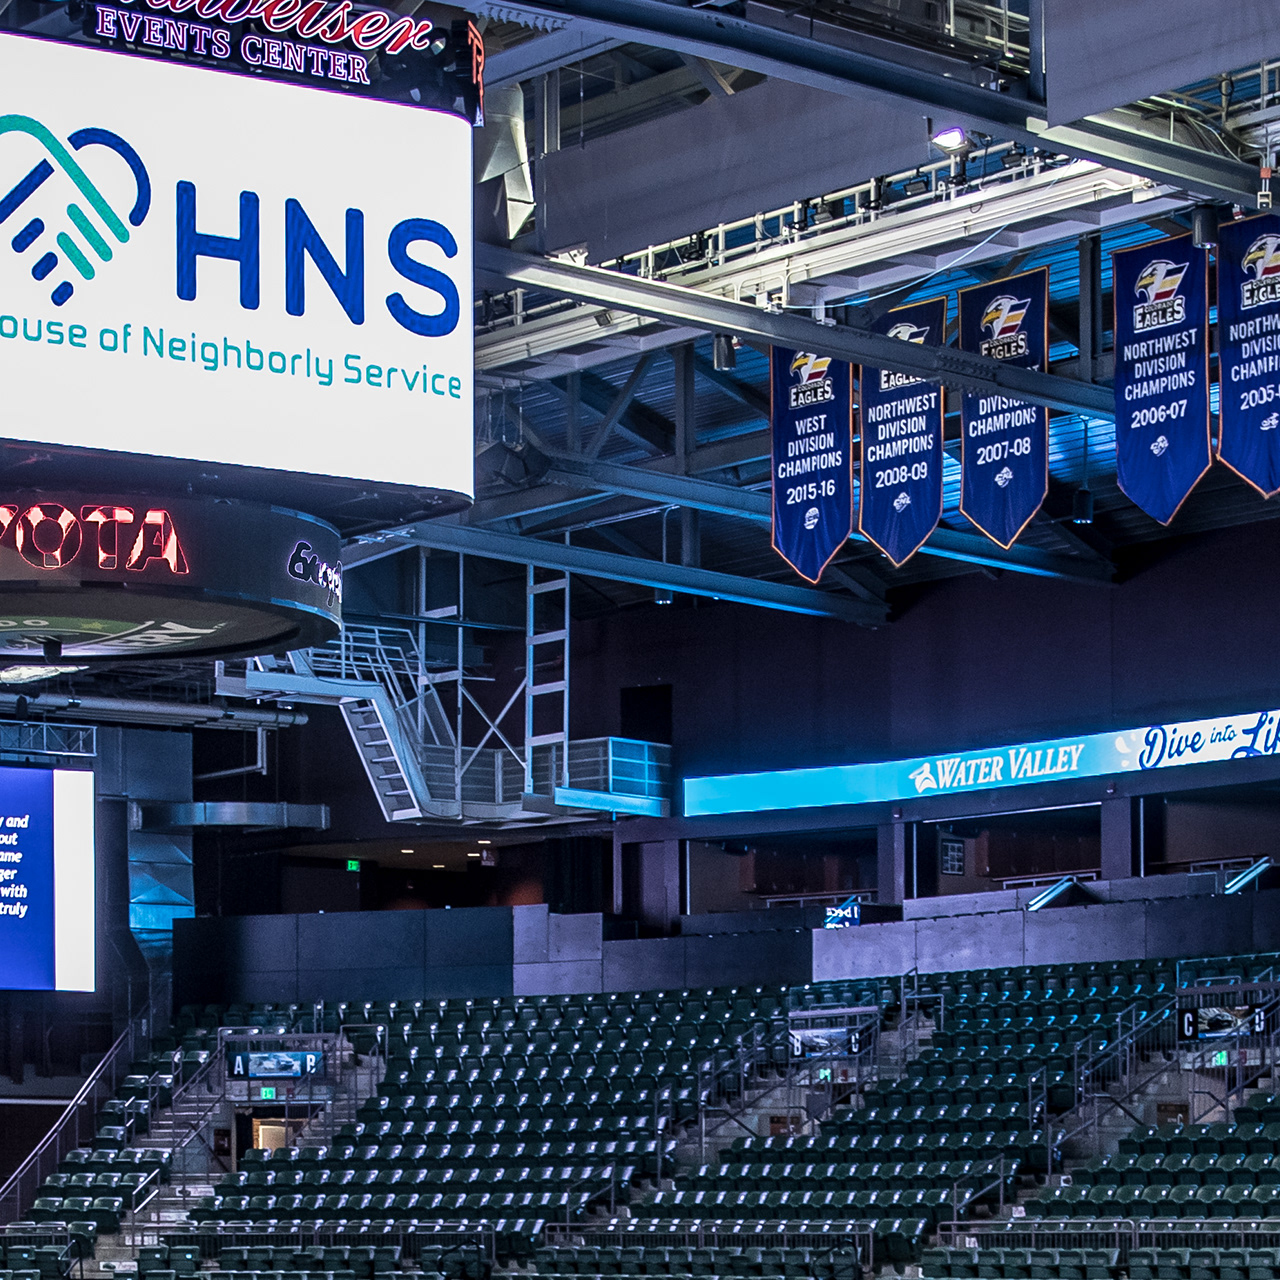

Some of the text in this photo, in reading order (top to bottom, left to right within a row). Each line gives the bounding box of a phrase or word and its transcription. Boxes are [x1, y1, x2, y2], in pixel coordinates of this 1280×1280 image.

[96, 7, 231, 58] EVENTS
[241, 36, 370, 84] CENTER
[176, 180, 460, 337] HNS
[1135, 298, 1184, 332] EAGLES
[1123, 328, 1198, 360] NORTHWEST
[99, 324, 132, 354] of
[143, 327, 333, 386] Neighborly
[344, 355, 462, 399] Service
[1134, 353, 1186, 378] DIVISION
[790, 379, 832, 407] EAGLES
[1125, 371, 1195, 401] CHAMPIONS
[867, 393, 938, 423] NORTHWEST
[1130, 401, 1188, 428] 2006-07
[795, 415, 827, 435] WEST
[877, 419, 927, 441] DIVISION
[969, 409, 1037, 438] CHAMPIONS
[788, 434, 834, 457] DIVISION
[867, 435, 934, 463] CHAMPIONS
[976, 438, 1031, 465] 2007-08
[778, 451, 842, 479] CHAMPIONS
[875, 463, 928, 488] 2008-09
[786, 479, 836, 505] 2015-16
[1139, 725, 1205, 770] Dive
[1210, 726, 1237, 744] into
[935, 745, 1084, 789] WATER VALLEY
[6, 815, 29, 828] and
[0, 885, 28, 898] with
[1184, 1013, 1192, 1036] C
[234, 1056, 244, 1075] A
